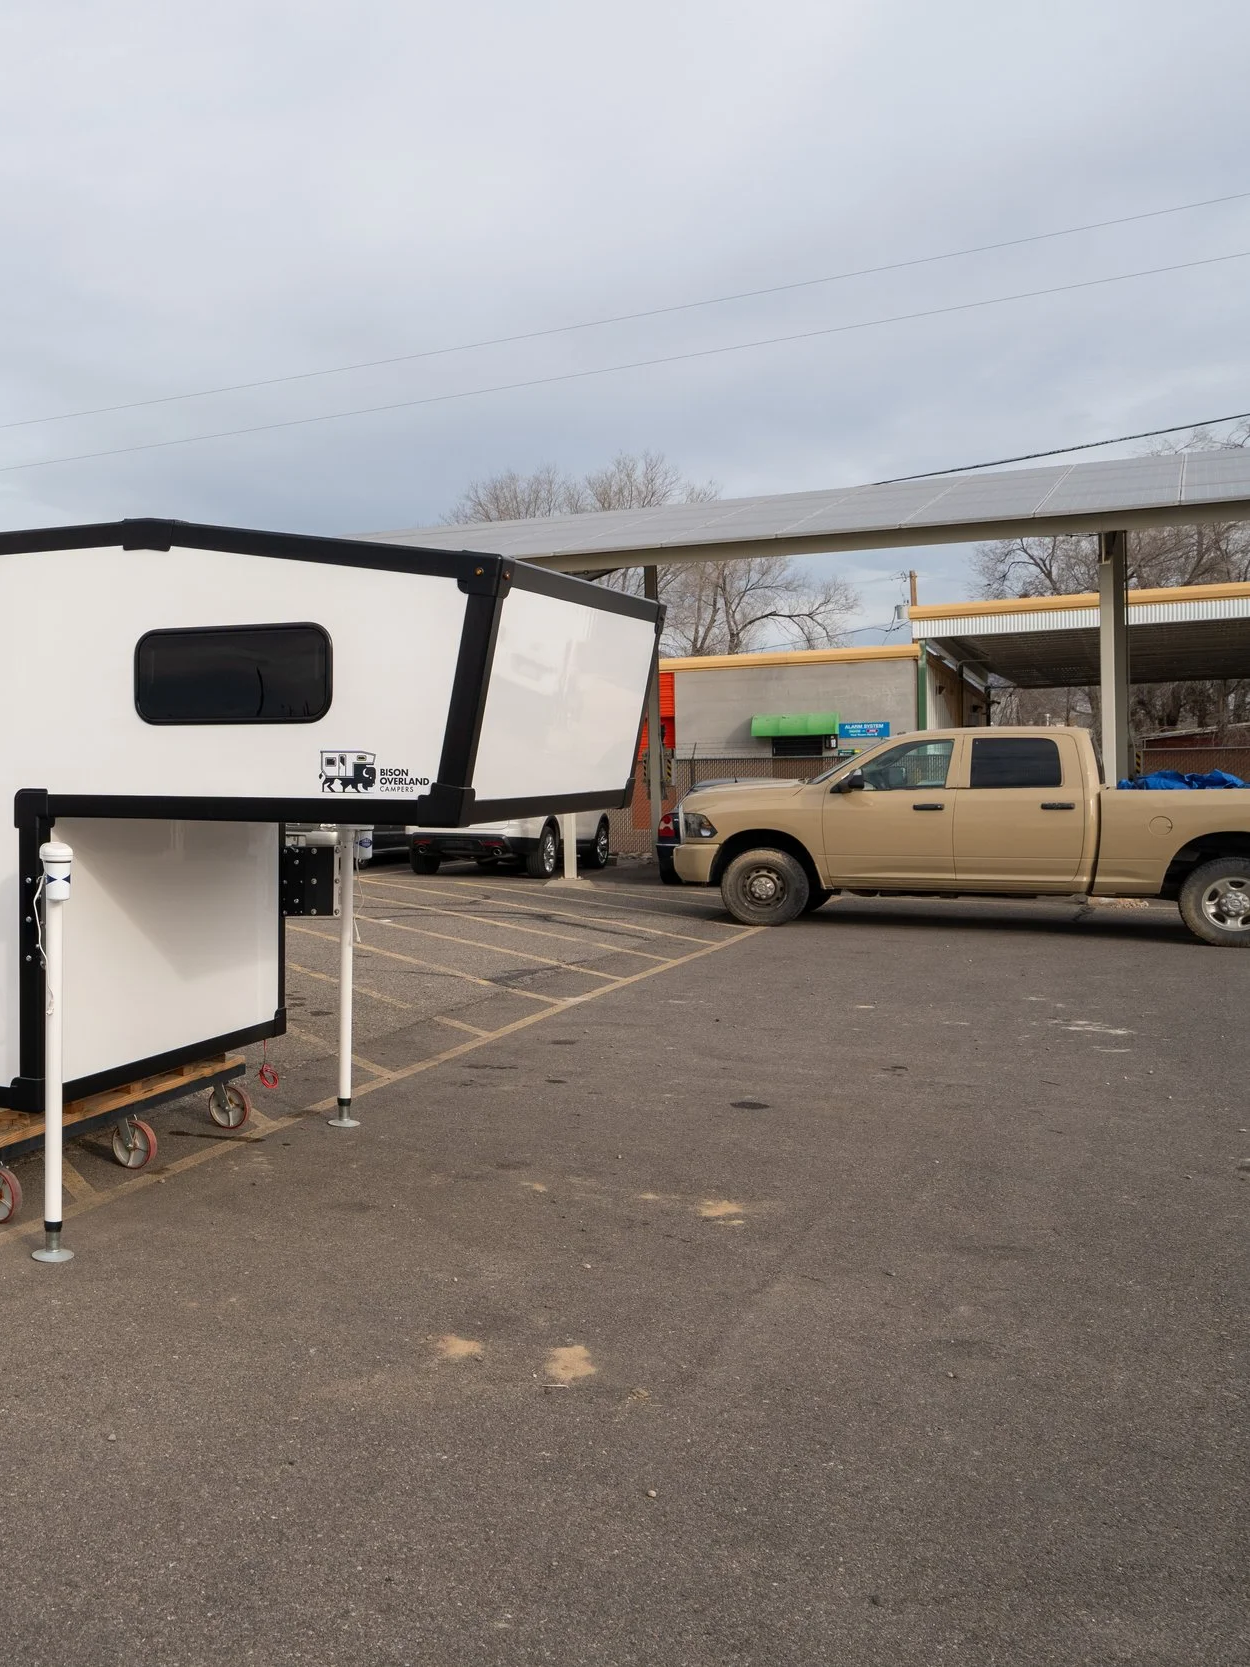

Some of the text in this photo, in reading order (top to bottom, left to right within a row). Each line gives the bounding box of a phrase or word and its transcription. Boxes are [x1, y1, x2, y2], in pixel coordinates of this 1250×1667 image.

[380, 768, 409, 777] BISON
[380, 777, 430, 786] OVERLAND
[380, 785, 414, 793] CAMPERS
